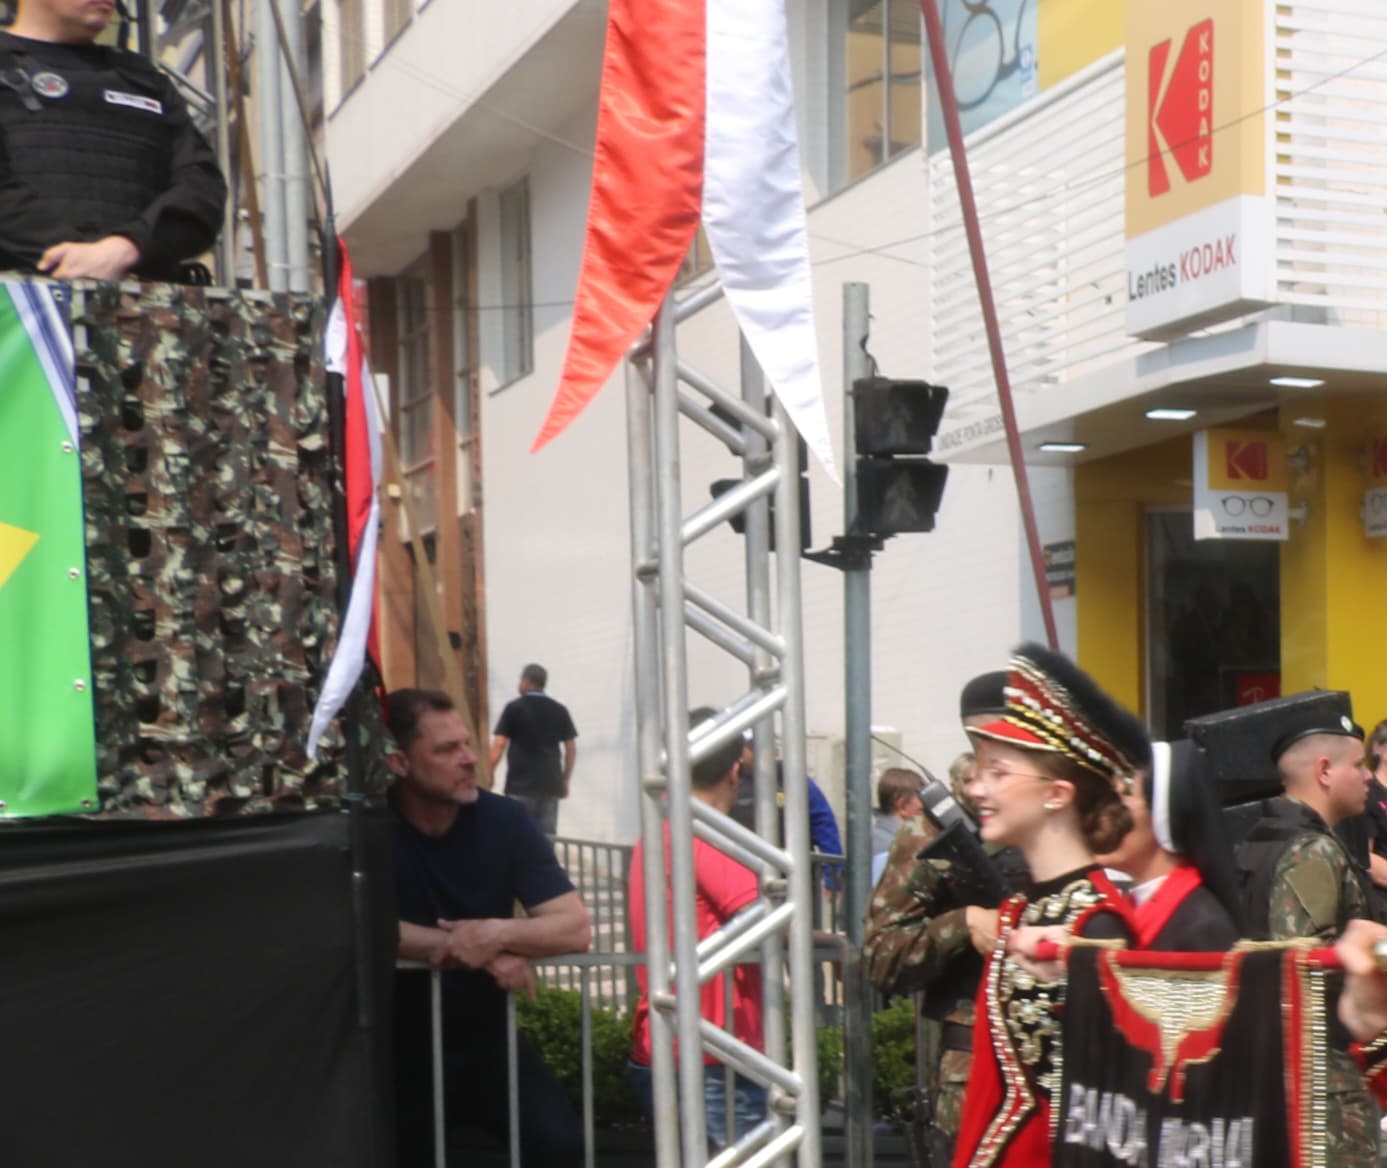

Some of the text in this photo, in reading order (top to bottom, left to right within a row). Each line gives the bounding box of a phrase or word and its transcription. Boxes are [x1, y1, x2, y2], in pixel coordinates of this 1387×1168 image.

[1198, 31, 1210, 168] KODAK
[1128, 234, 1238, 302] Lentes KODAK
